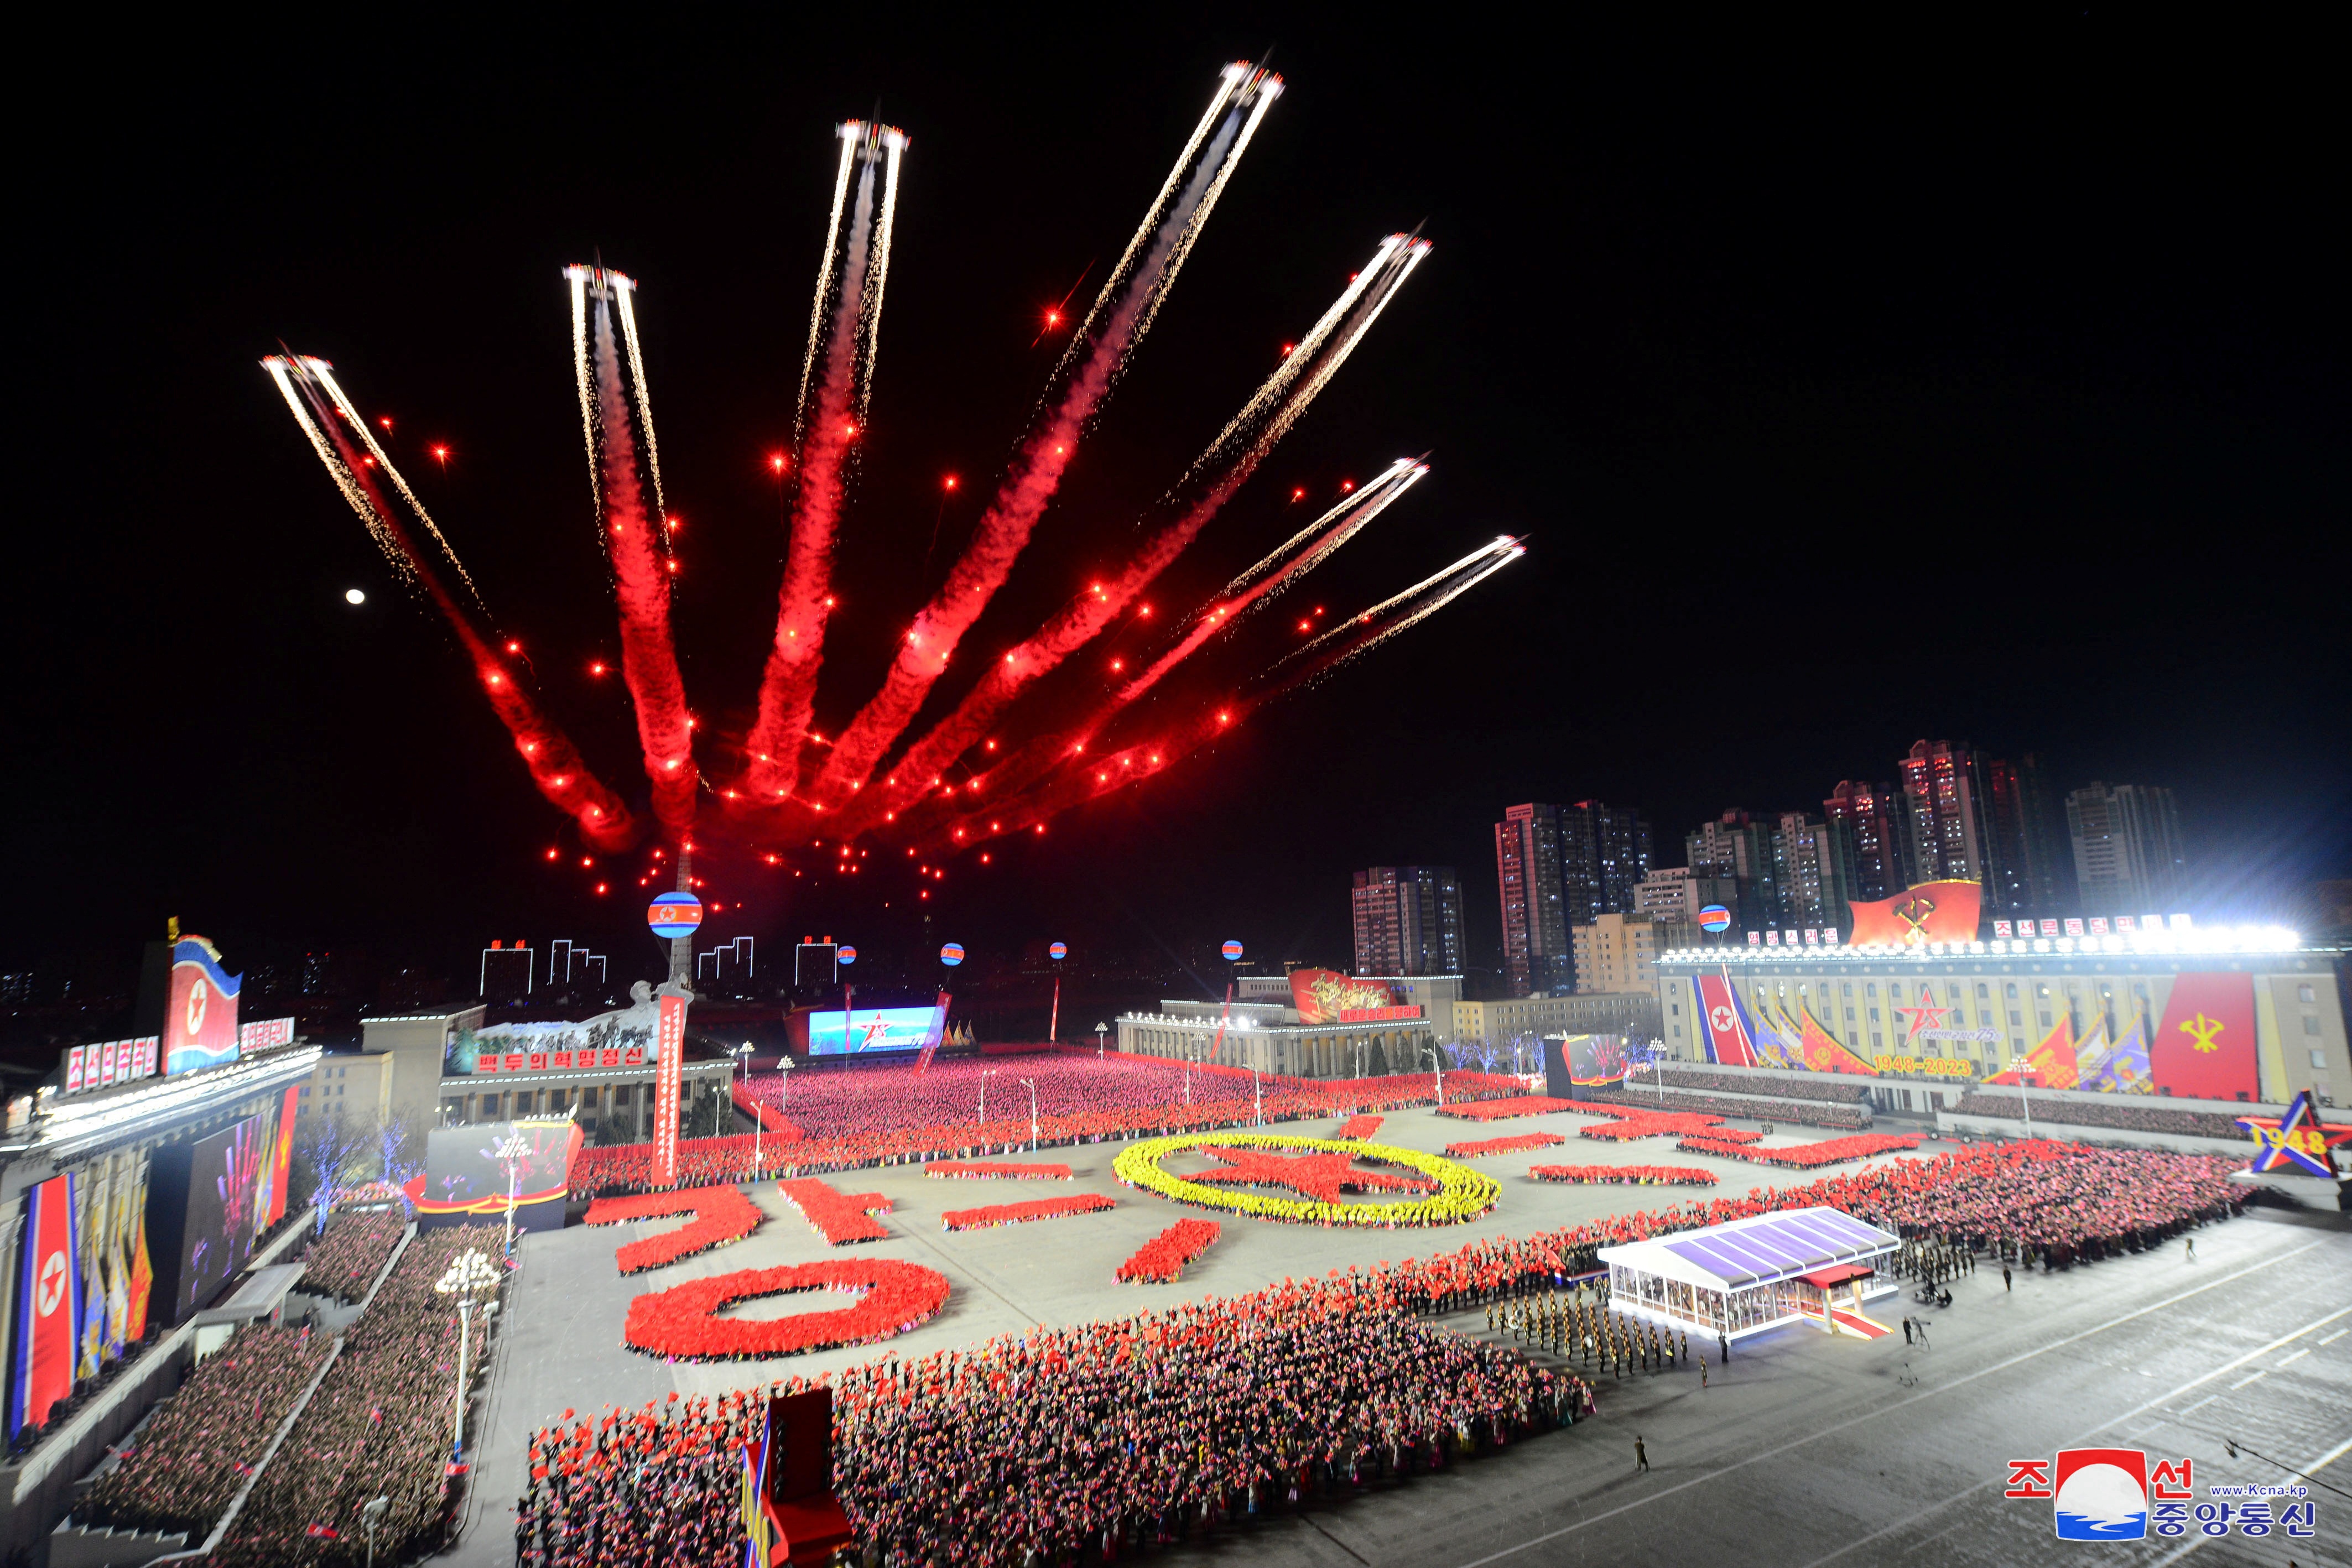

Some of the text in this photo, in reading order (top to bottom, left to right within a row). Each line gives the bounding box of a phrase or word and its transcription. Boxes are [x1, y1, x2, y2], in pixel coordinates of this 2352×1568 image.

[1750, 930, 1837, 945] 영광스러운
[1874, 1055, 1972, 1076] 1948-2023
[2251, 1127, 2328, 1155] 1948
